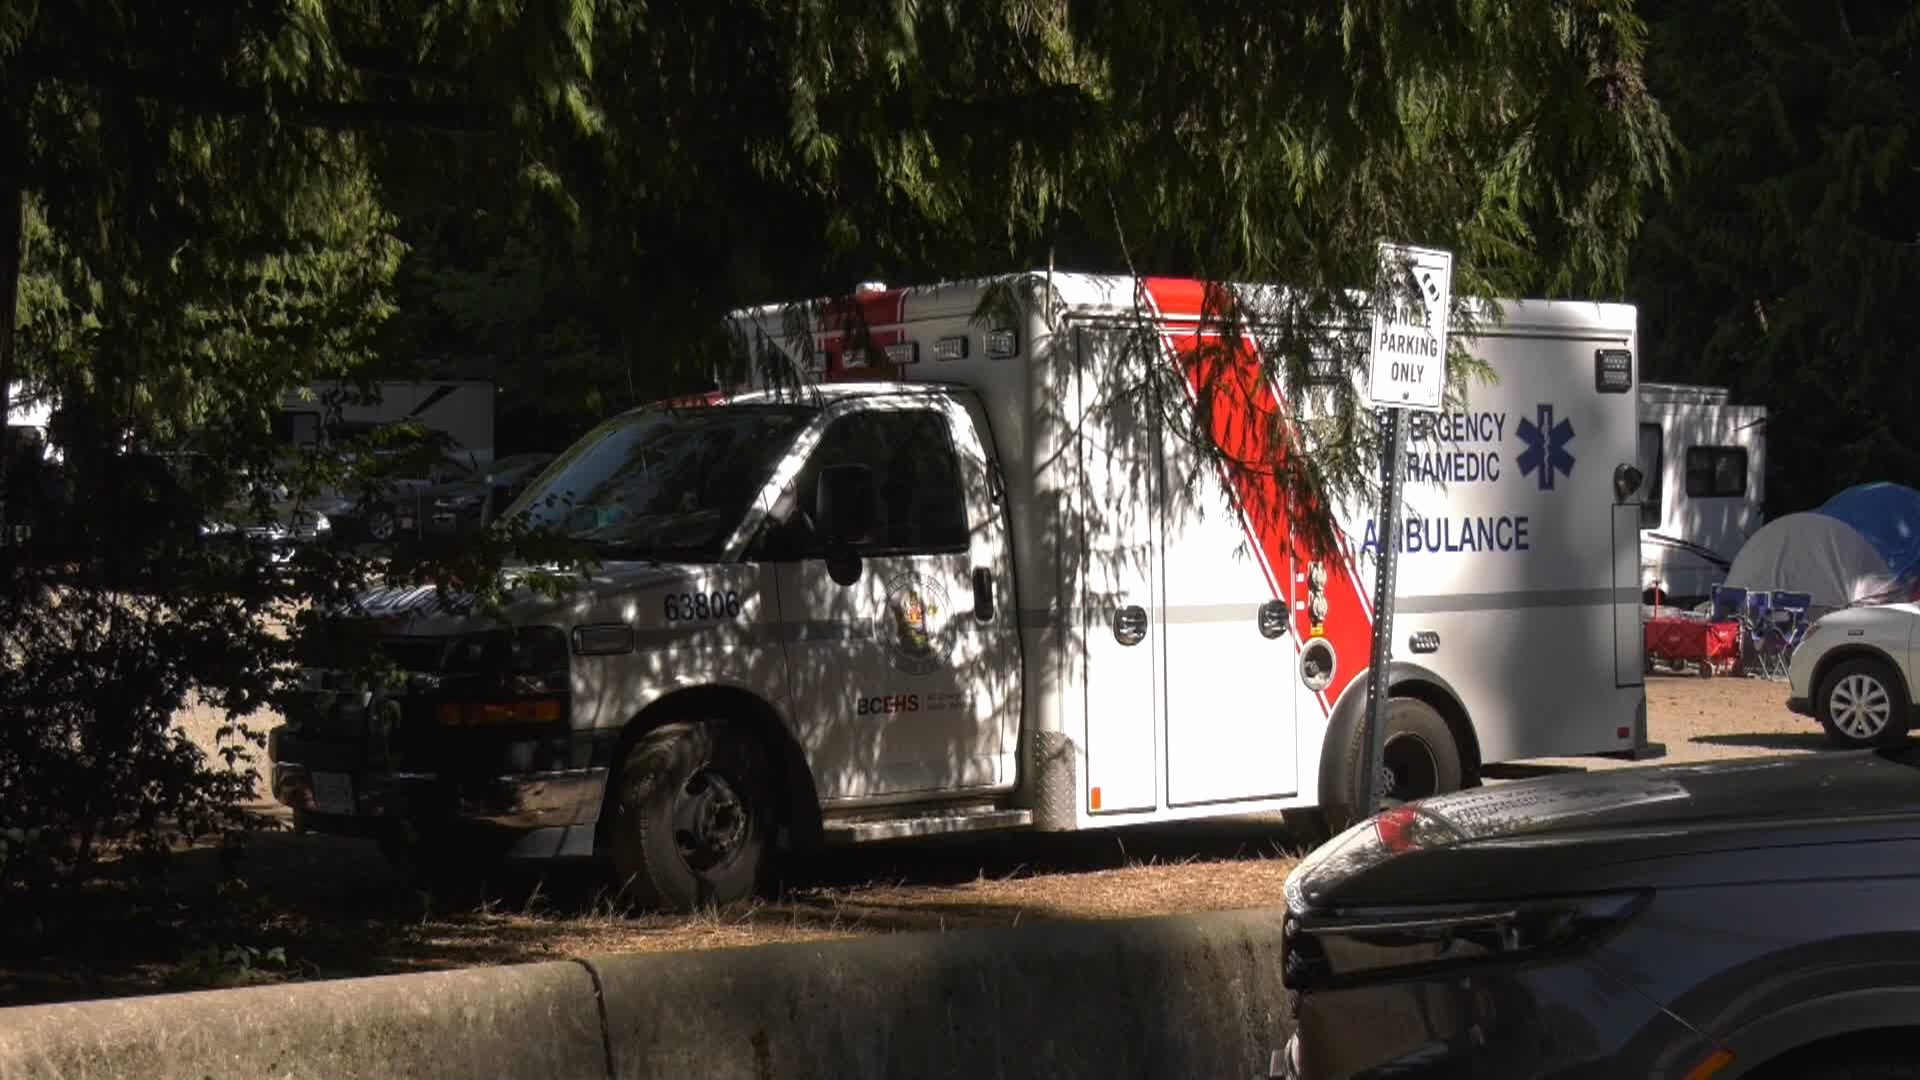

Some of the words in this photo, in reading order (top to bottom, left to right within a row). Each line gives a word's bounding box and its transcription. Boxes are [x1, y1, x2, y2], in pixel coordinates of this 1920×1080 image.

[1379, 332, 1438, 357] PARKING
[1391, 361, 1425, 384] ONLY
[1376, 411, 1506, 442] ERGENCY
[1380, 452, 1500, 482] RAMEDIC
[1361, 516, 1529, 553] ABULANCE
[663, 590, 740, 622] 63806
[857, 694, 919, 716] BCEHS
